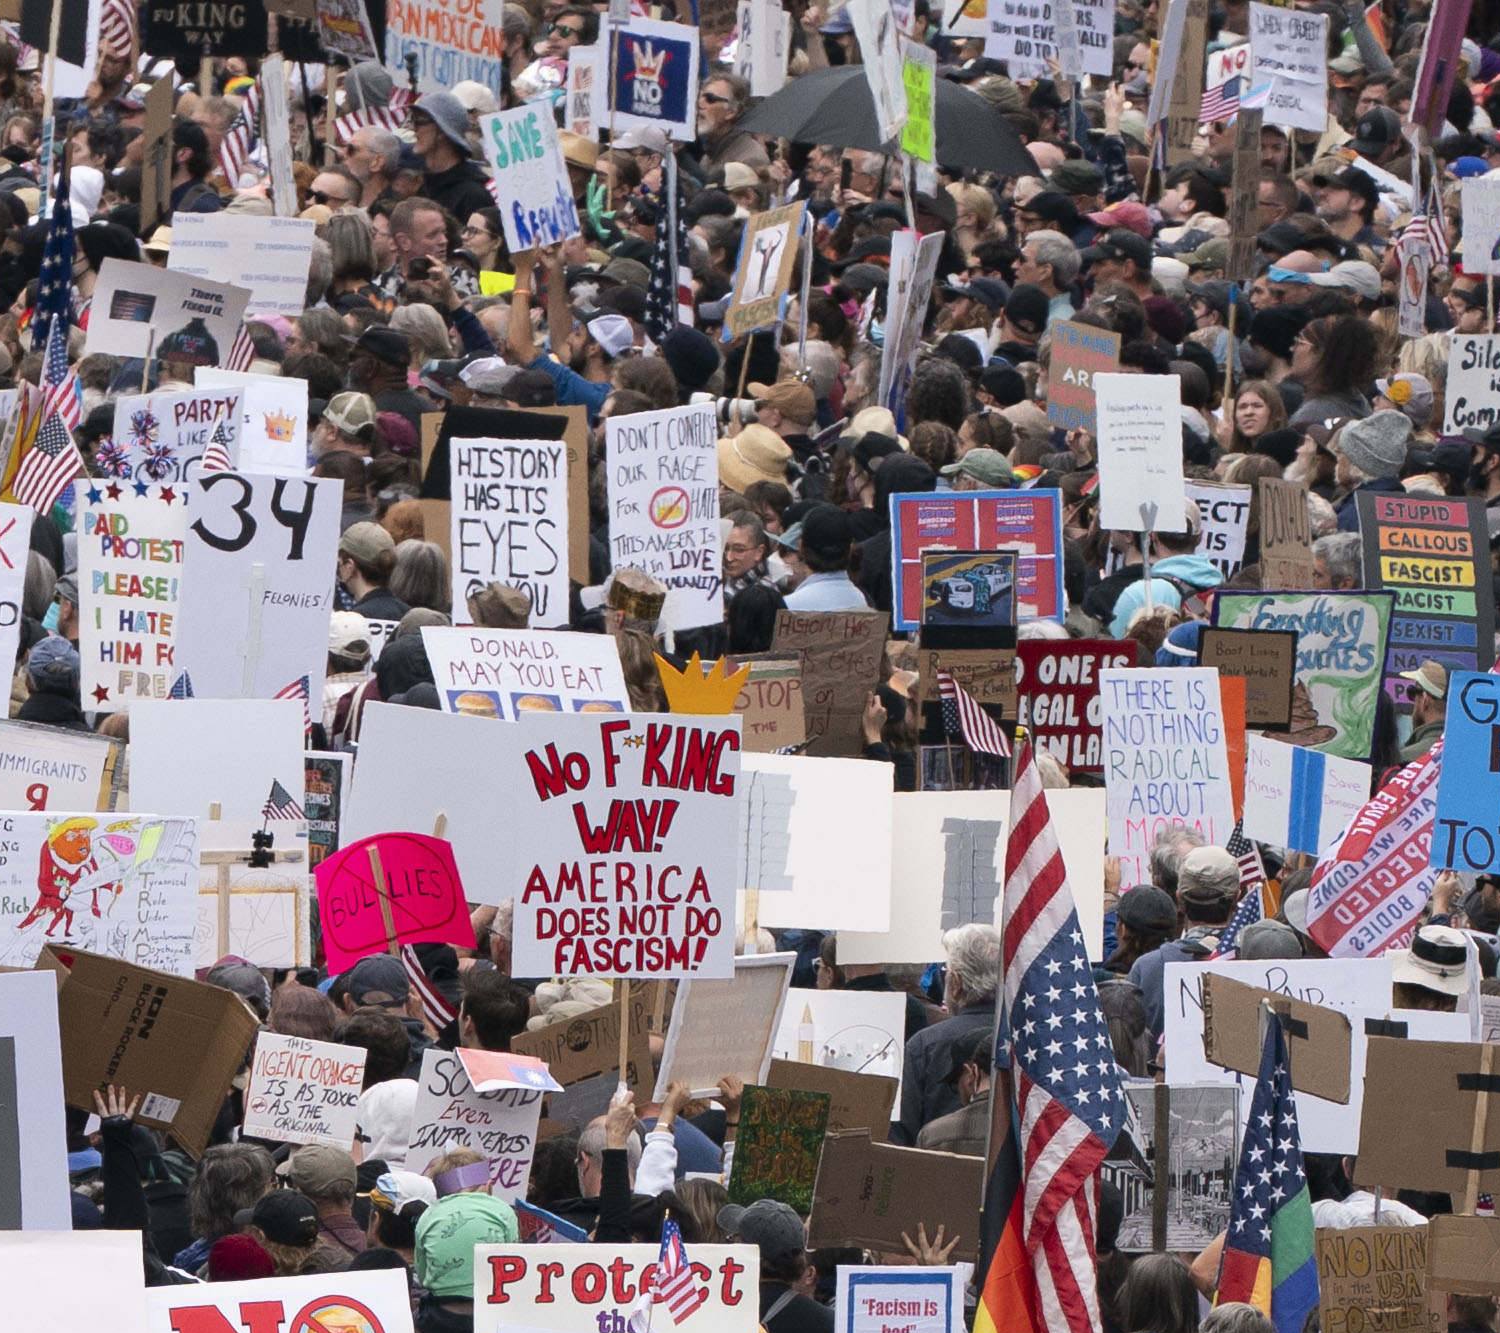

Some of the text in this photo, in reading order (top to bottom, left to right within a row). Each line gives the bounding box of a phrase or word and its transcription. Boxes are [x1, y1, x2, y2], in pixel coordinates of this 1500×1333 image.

[457, 445, 560, 482] HISTORY
[190, 473, 319, 562] 34
[1383, 499, 1451, 526] STUPID
[1388, 558, 1466, 585] FASCIST
[262, 586, 333, 609] FELONIES!
[553, 935, 709, 977] FASCISM!
[273, 1117, 333, 1135] ORIGINAL
[438, 1100, 493, 1125] Even
